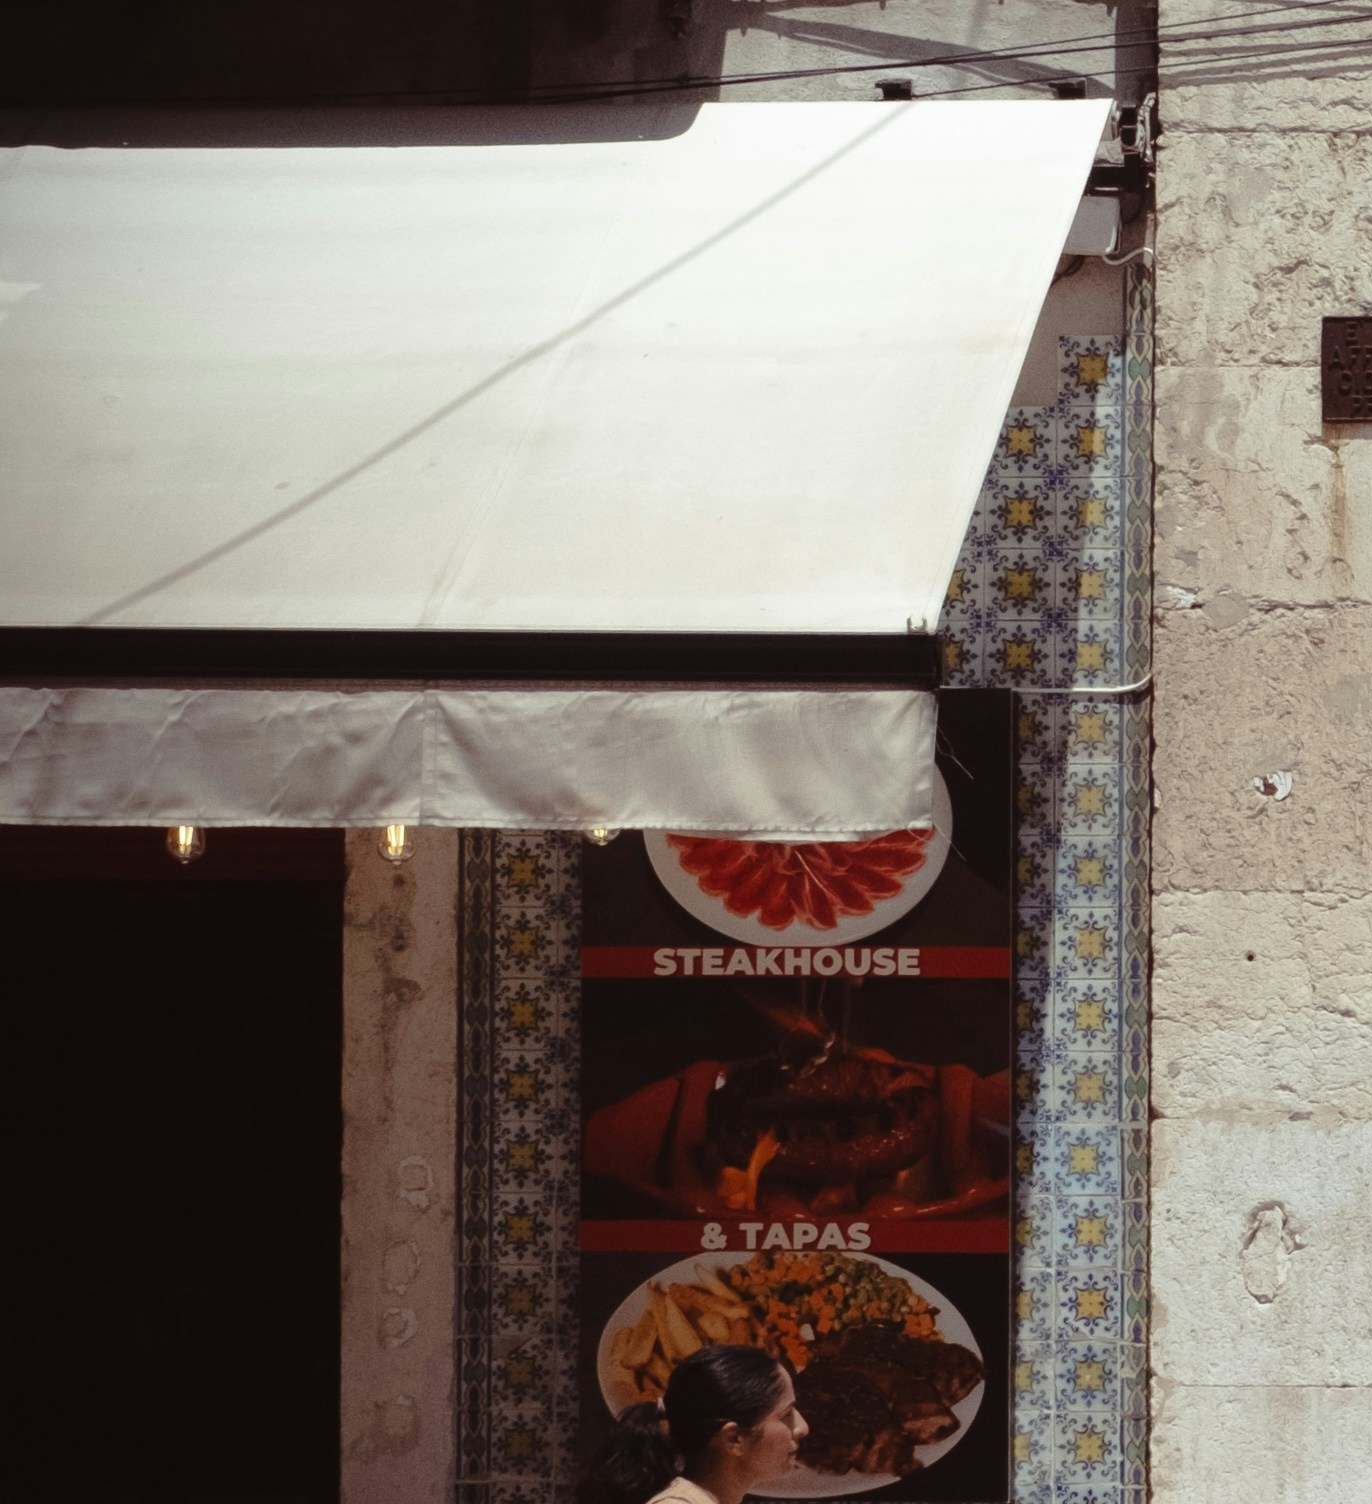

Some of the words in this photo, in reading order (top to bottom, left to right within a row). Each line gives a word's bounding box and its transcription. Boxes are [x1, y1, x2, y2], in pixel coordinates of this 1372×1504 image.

[653, 948, 921, 976] STEAKHOUSE
[700, 1222, 727, 1250] &
[739, 1222, 871, 1250] TAPAS
